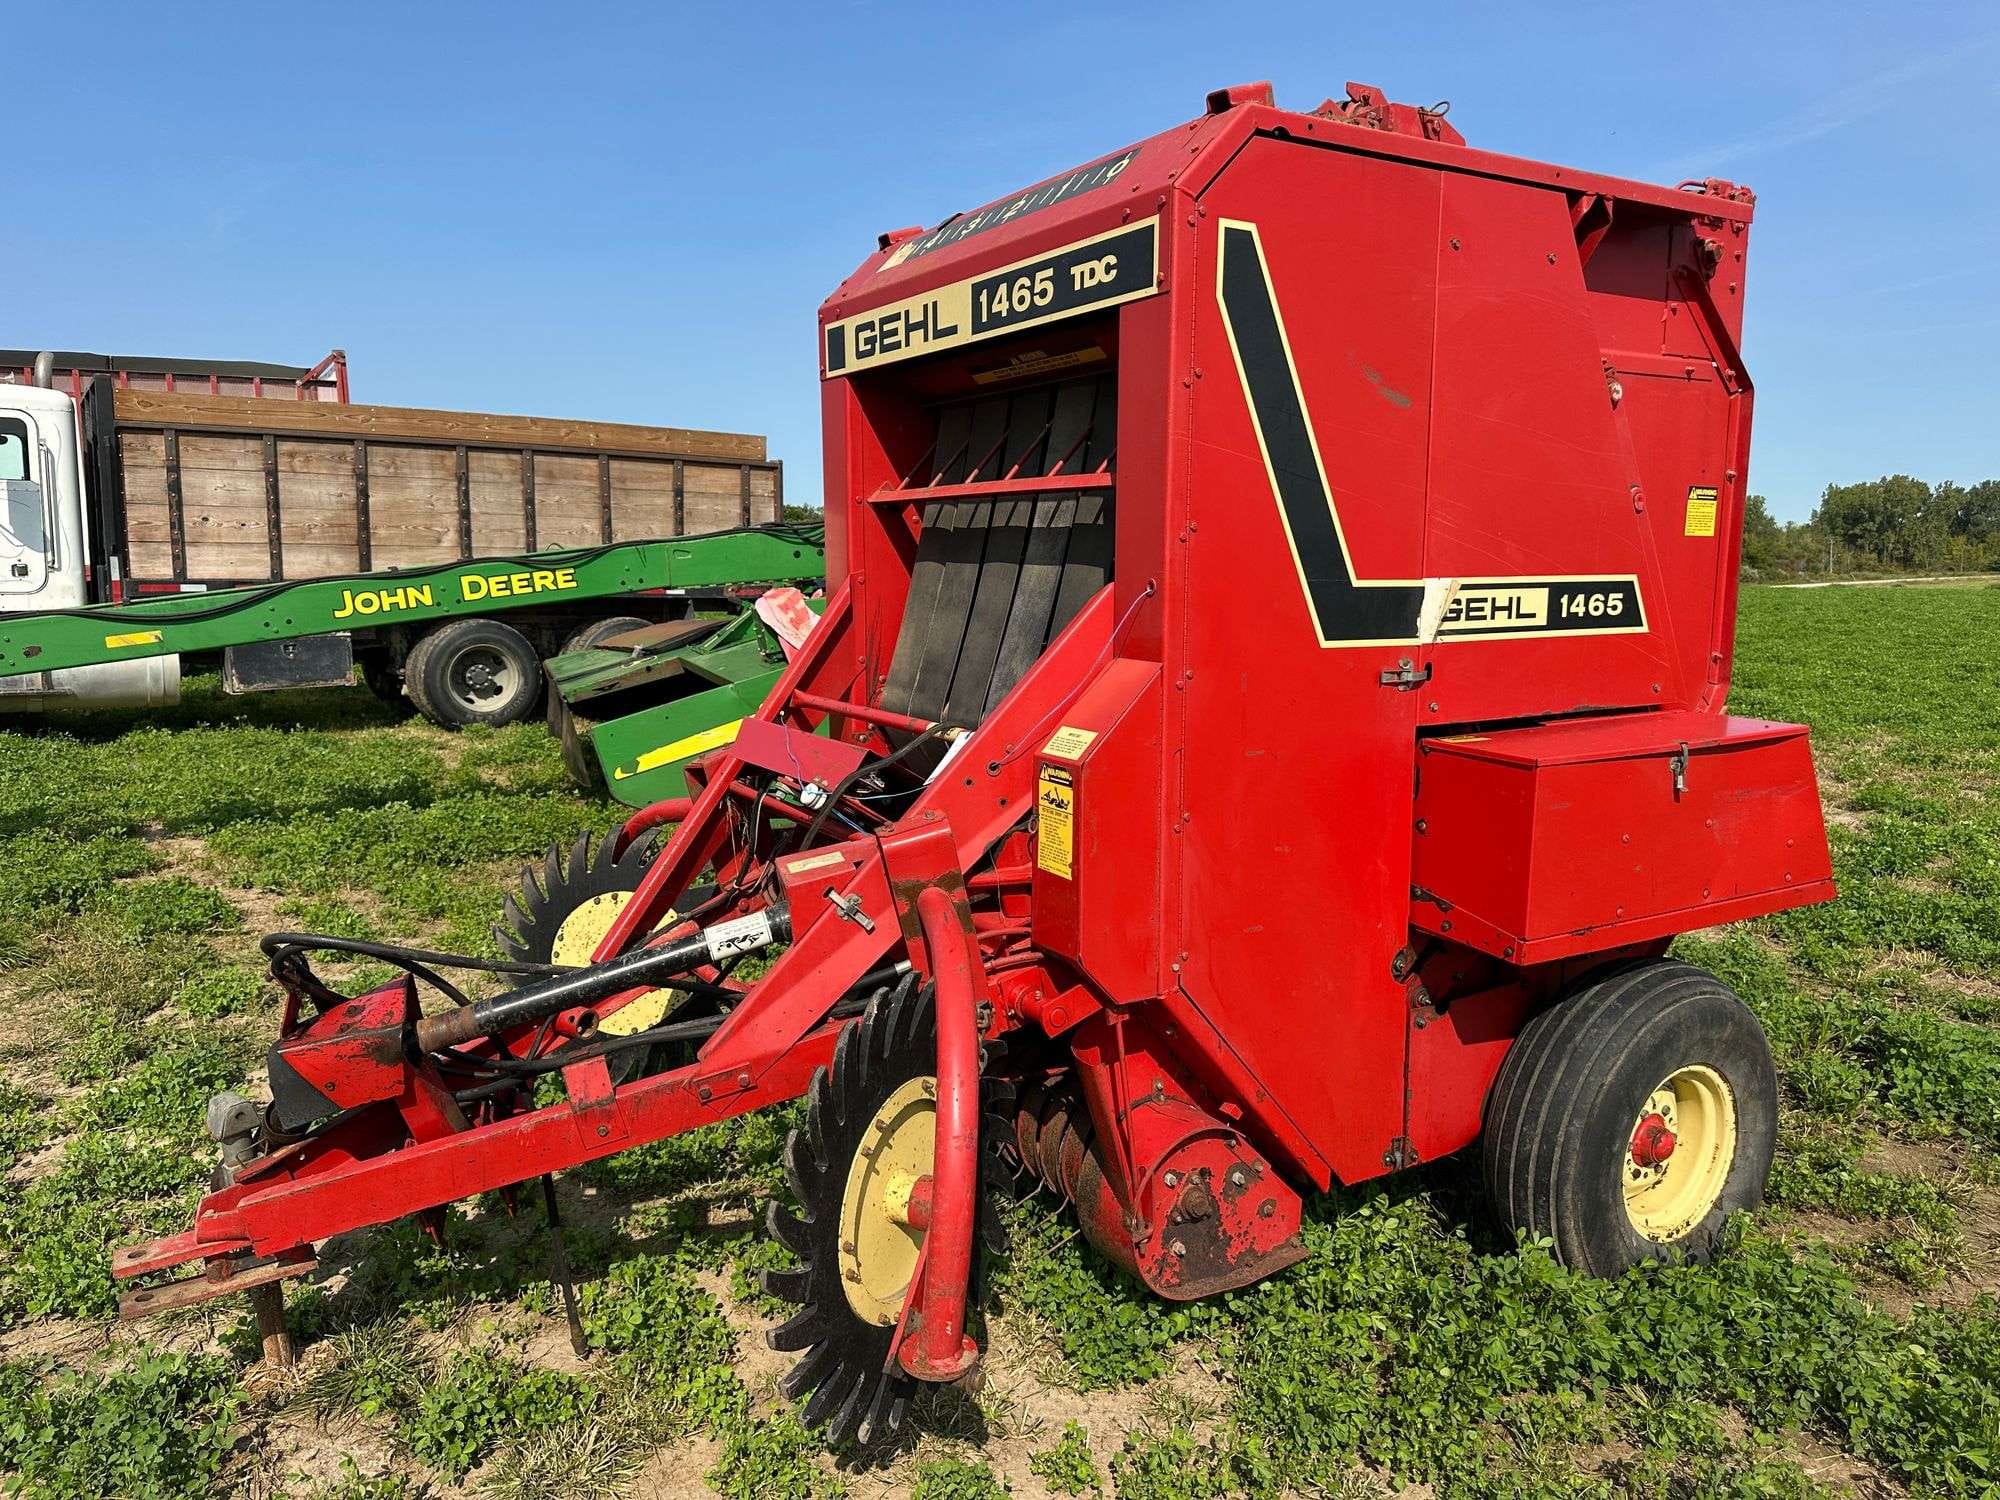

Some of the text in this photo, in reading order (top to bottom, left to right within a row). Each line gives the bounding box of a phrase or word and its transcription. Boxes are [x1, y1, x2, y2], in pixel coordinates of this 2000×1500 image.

[855, 254, 1118, 360] GEHL 1465 TDC
[333, 567, 578, 619] JOHN DEERE
[1441, 592, 1624, 623] GEHL 1465
